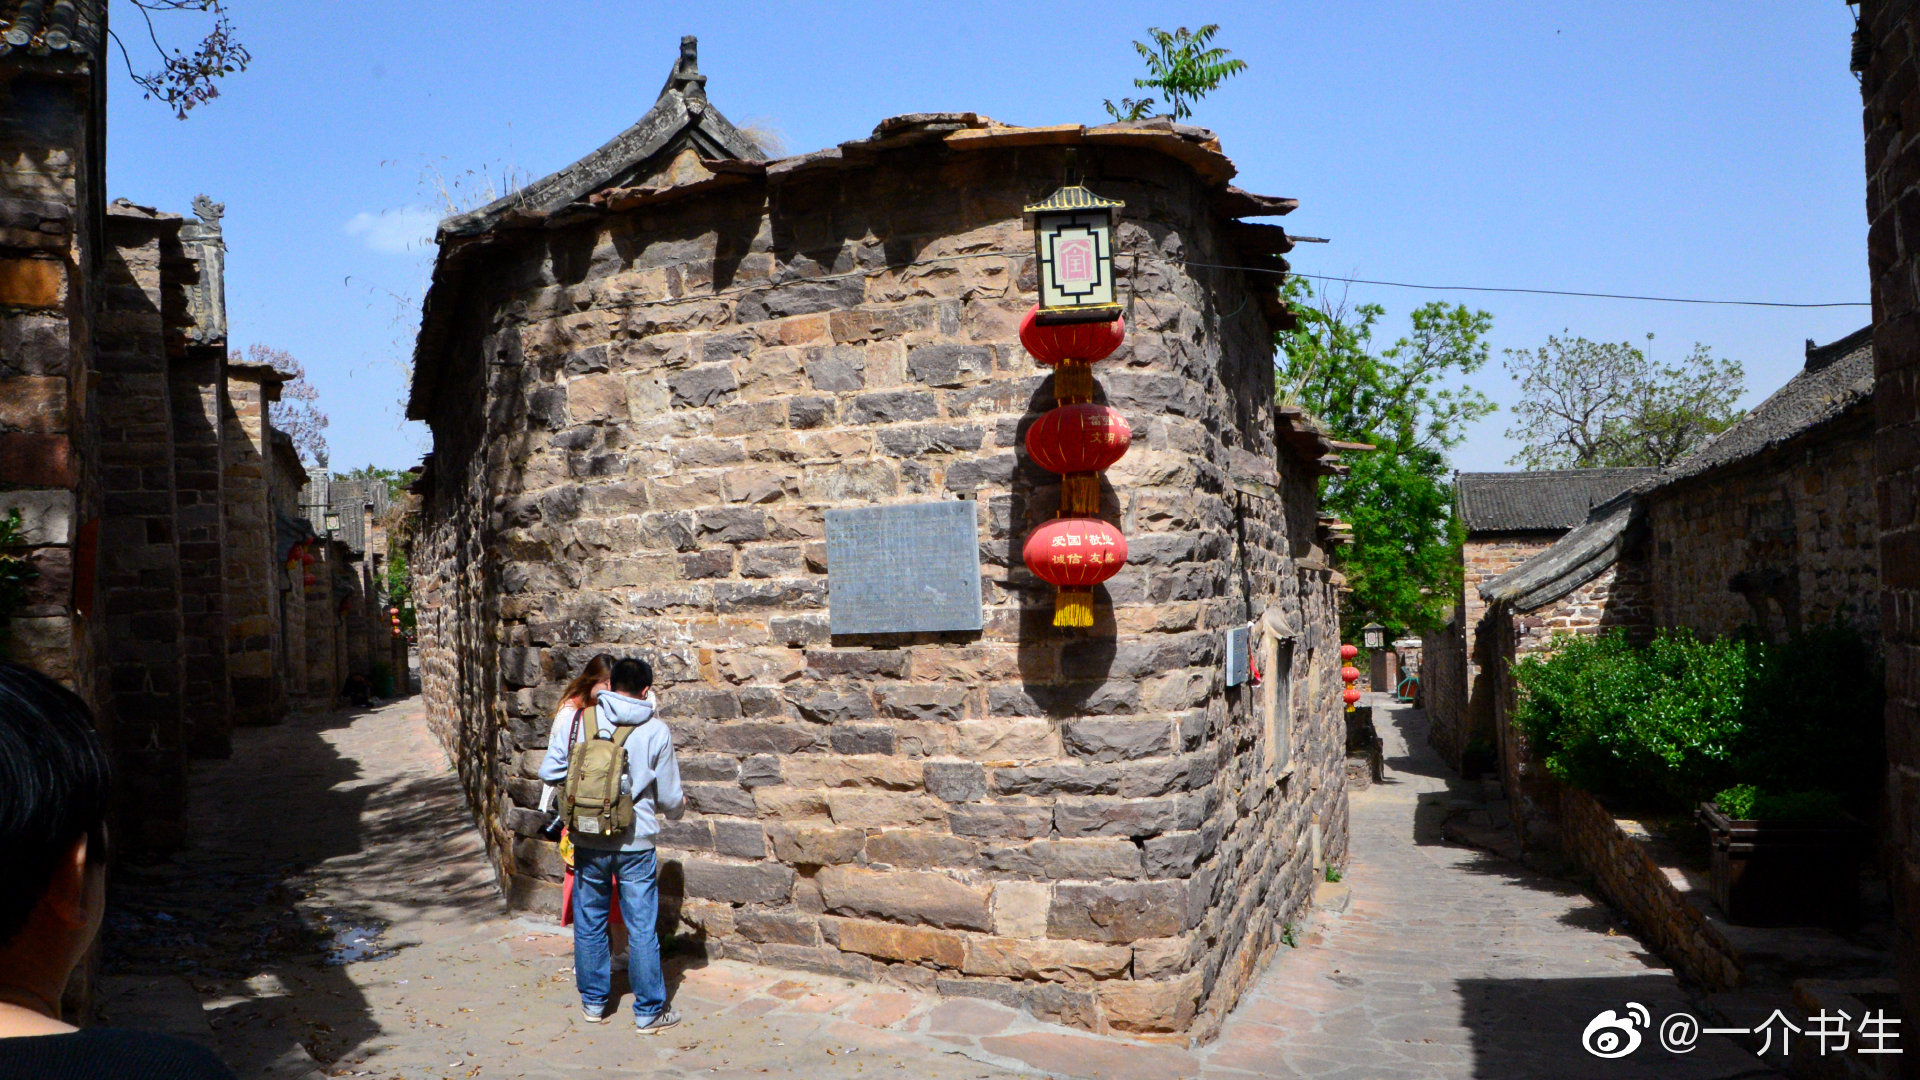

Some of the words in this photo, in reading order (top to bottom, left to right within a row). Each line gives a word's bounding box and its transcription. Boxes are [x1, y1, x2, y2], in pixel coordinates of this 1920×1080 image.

[1051, 535, 1081, 547] 爱国
[1089, 535, 1115, 546] 敬业
[1051, 553, 1083, 564] 诚信
